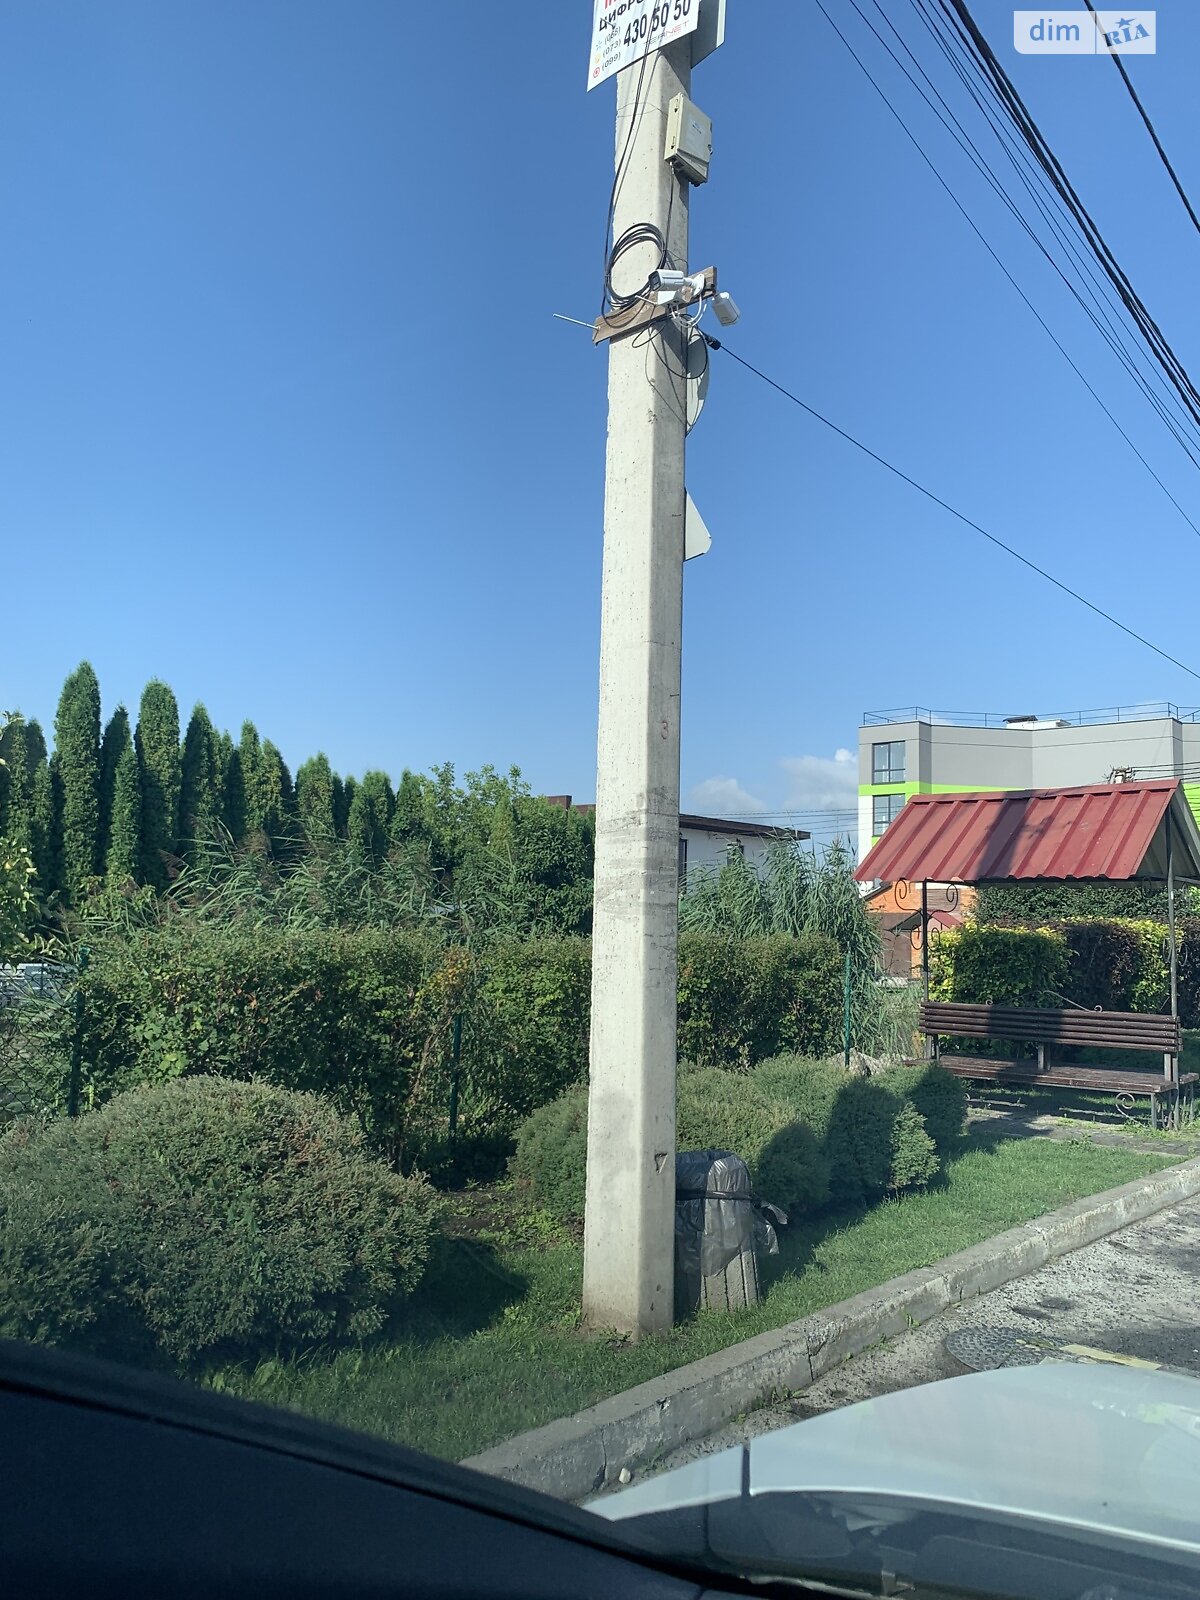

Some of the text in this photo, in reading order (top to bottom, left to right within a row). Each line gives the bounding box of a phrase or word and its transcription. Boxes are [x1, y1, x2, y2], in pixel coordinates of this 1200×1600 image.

[623, 0, 691, 47] 430 50 50
[602, 38, 622, 58] (073)
[601, 51, 622, 71] (099)
